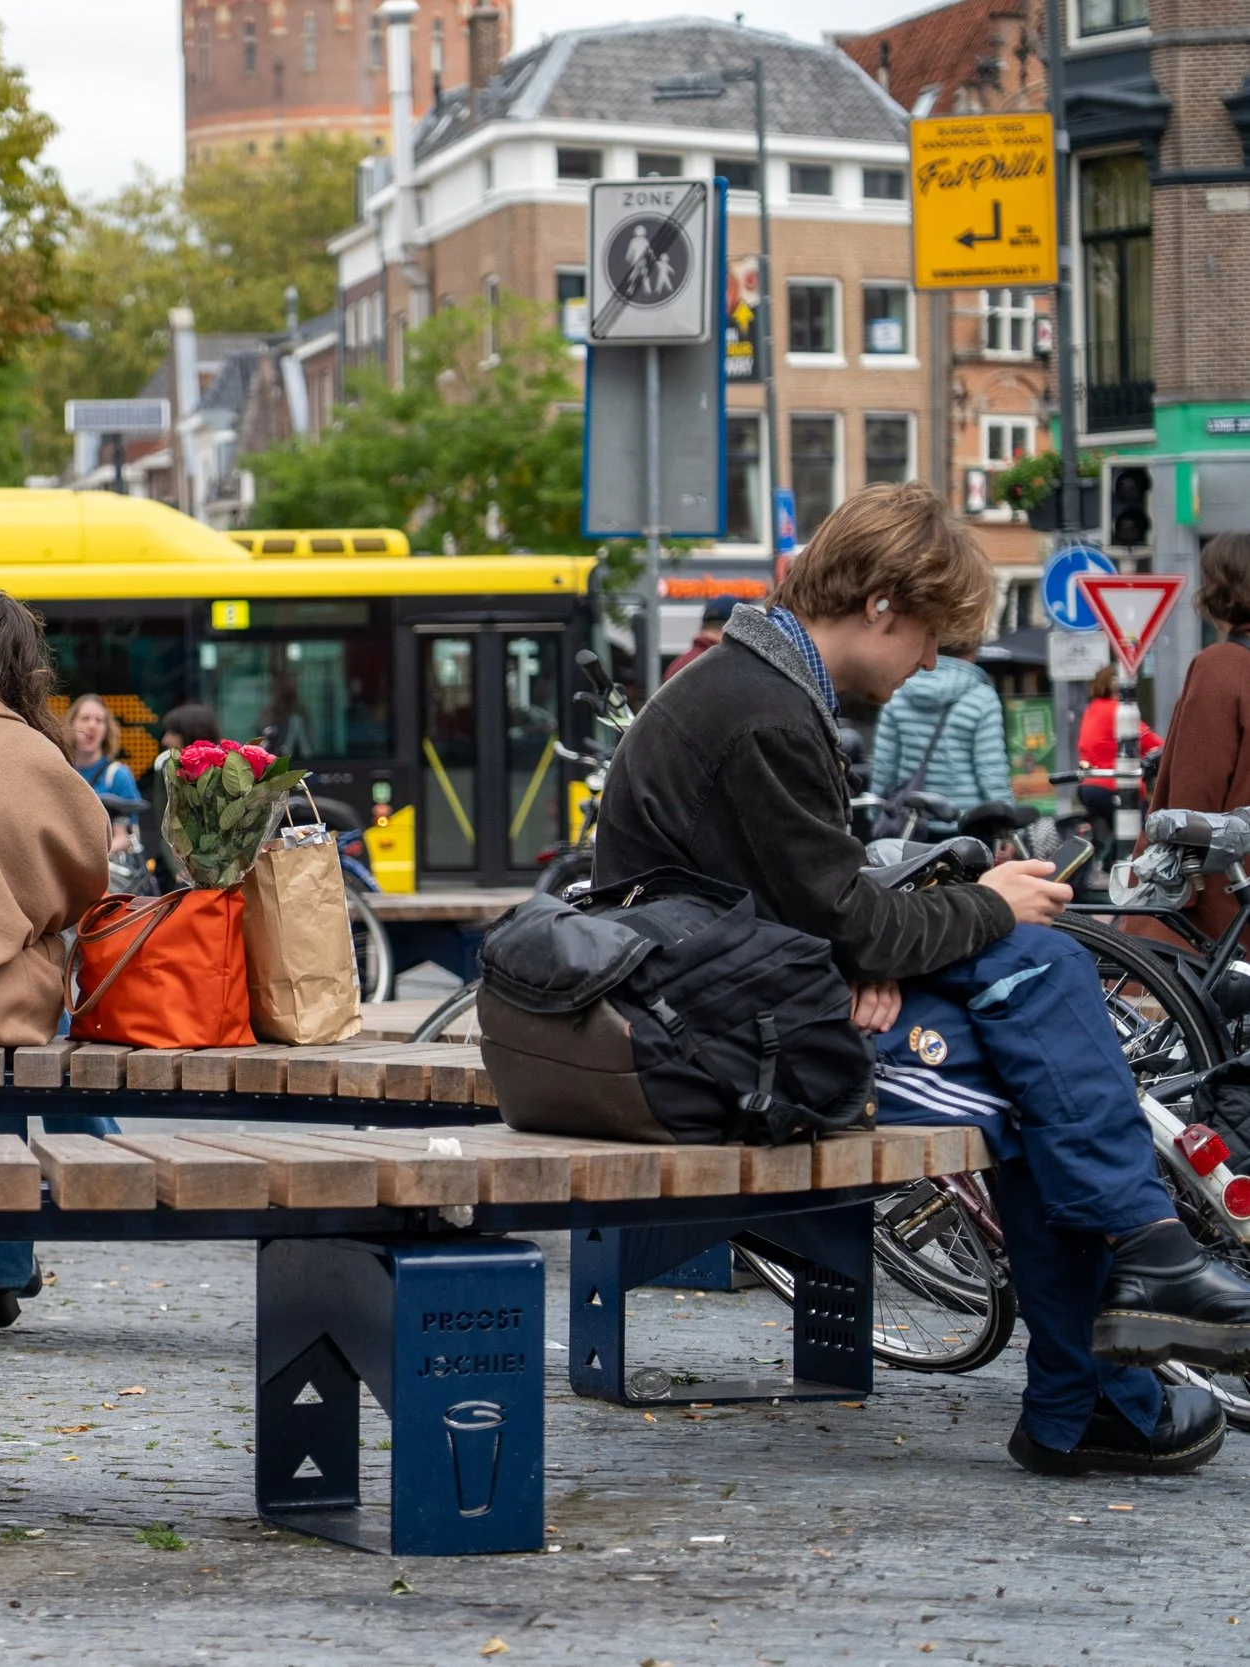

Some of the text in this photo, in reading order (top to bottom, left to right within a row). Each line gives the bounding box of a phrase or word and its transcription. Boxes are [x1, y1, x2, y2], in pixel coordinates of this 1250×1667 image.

[918, 156, 969, 197] Fat
[622, 191, 675, 206] ZONE
[421, 1308, 524, 1333] PROOST
[417, 1352, 526, 1379] JOCHIE!
